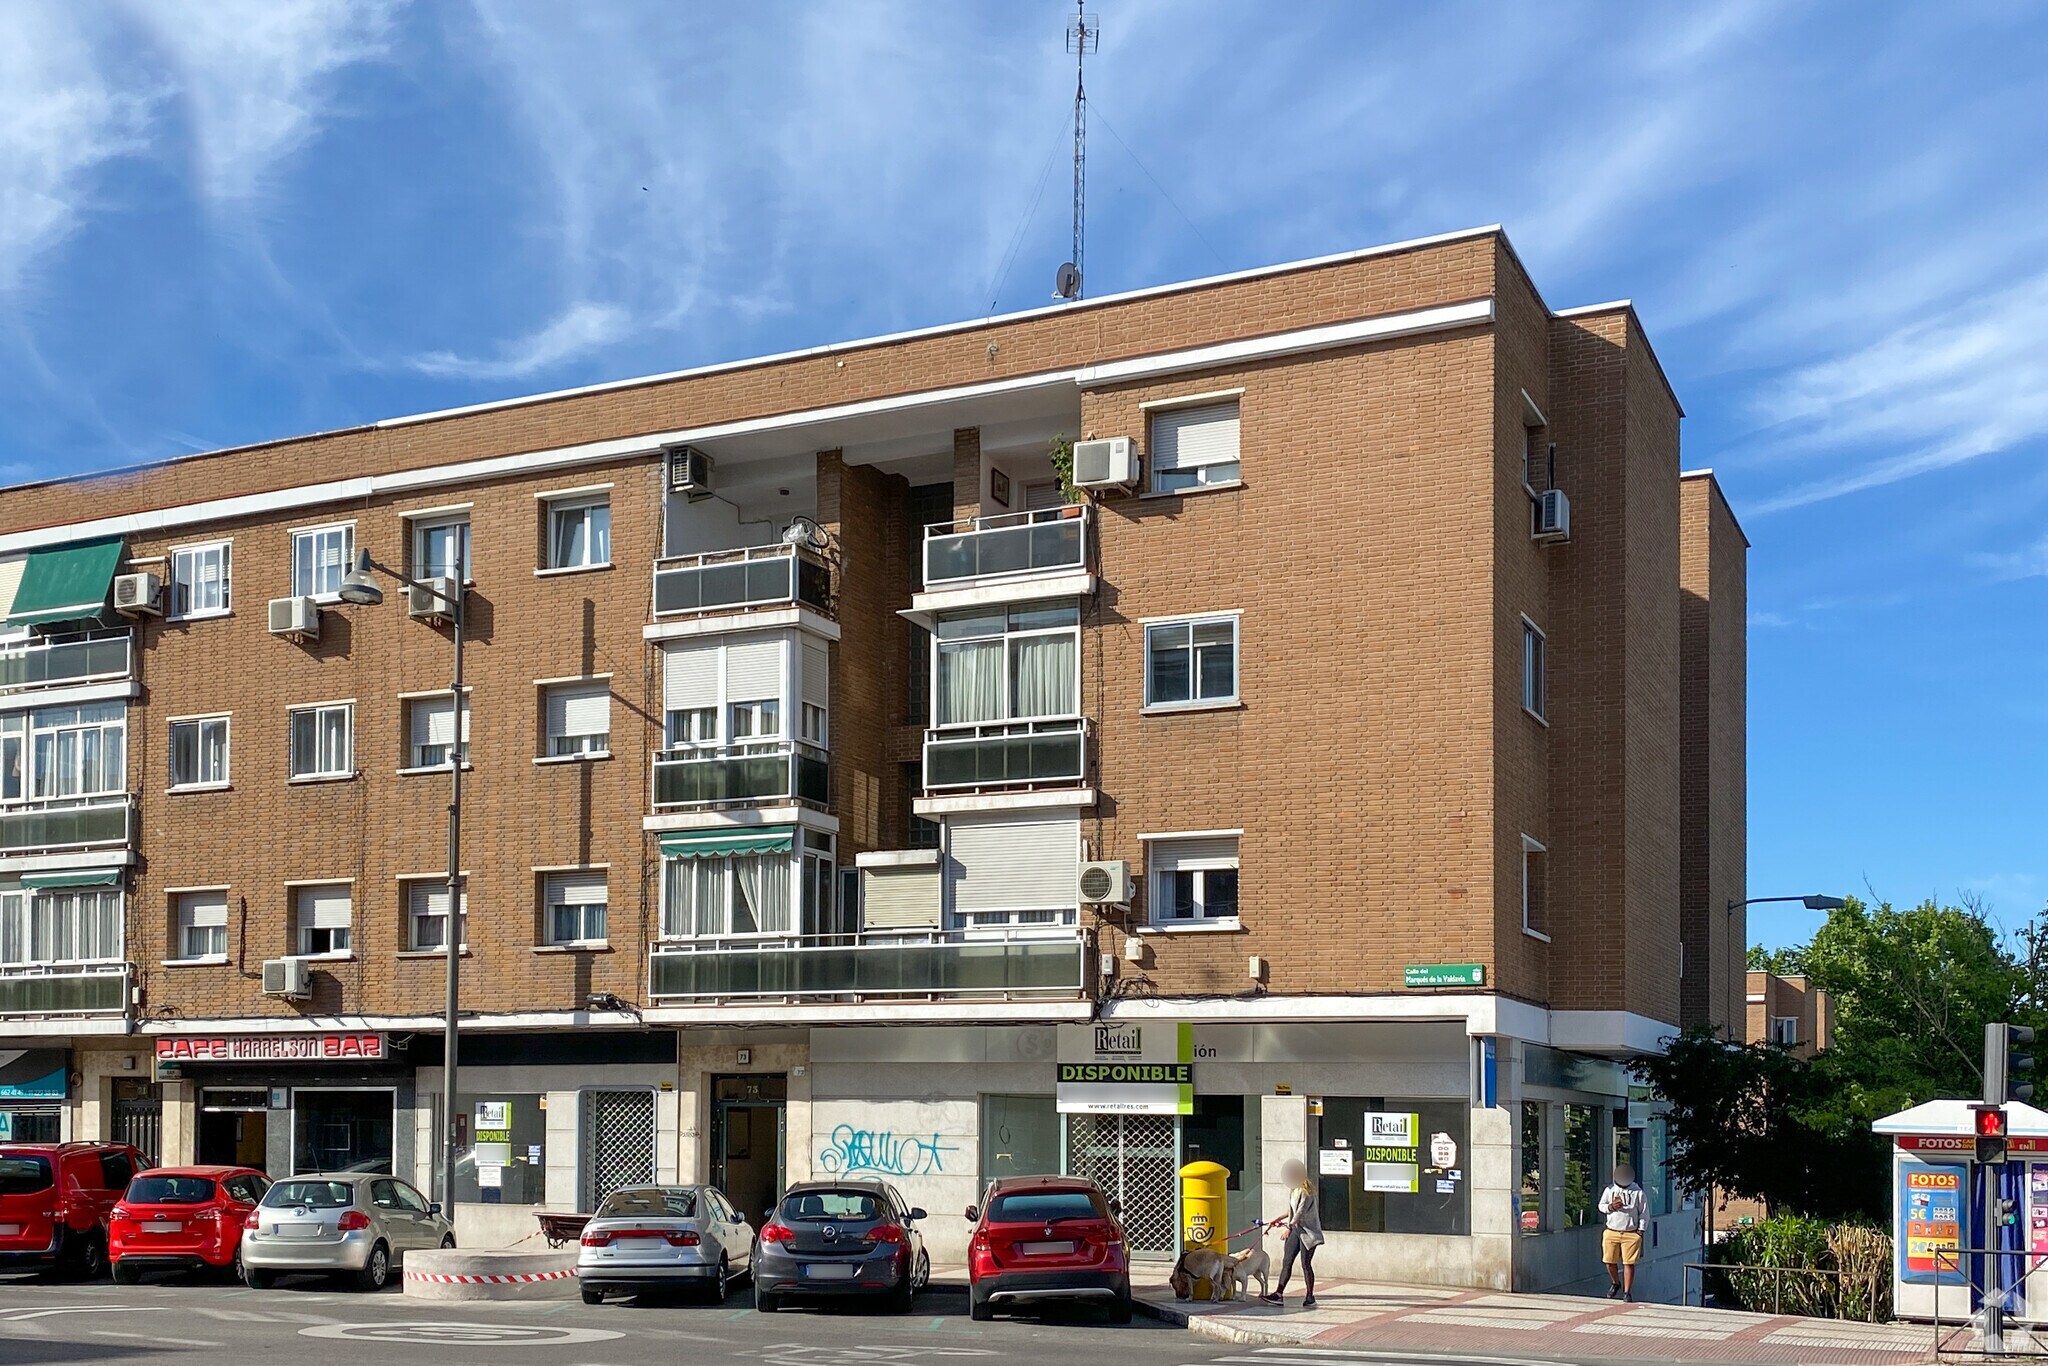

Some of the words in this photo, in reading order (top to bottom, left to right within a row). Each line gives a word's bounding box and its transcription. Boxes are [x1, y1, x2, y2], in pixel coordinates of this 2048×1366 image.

[1437, 975, 1442, 983] la
[1095, 1026, 1141, 1050] Retail
[157, 1039, 227, 1059] CAFE
[233, 1037, 319, 1058] HARRELSON
[324, 1036, 381, 1057] BAR
[739, 1053, 747, 1061] 73
[1062, 1065, 1188, 1081] DISPONIBLE
[481, 1105, 505, 1119] Retail
[1372, 1116, 1408, 1134] Retail
[476, 1130, 510, 1142] DISPONIBLE
[1918, 1138, 1962, 1149] FOTOS
[1366, 1148, 1417, 1162] DISPONIBLE
[1911, 1174, 1956, 1186] FOTOS
[1910, 1208, 1927, 1220] 5€
[1911, 1241, 1927, 1254] 2€
